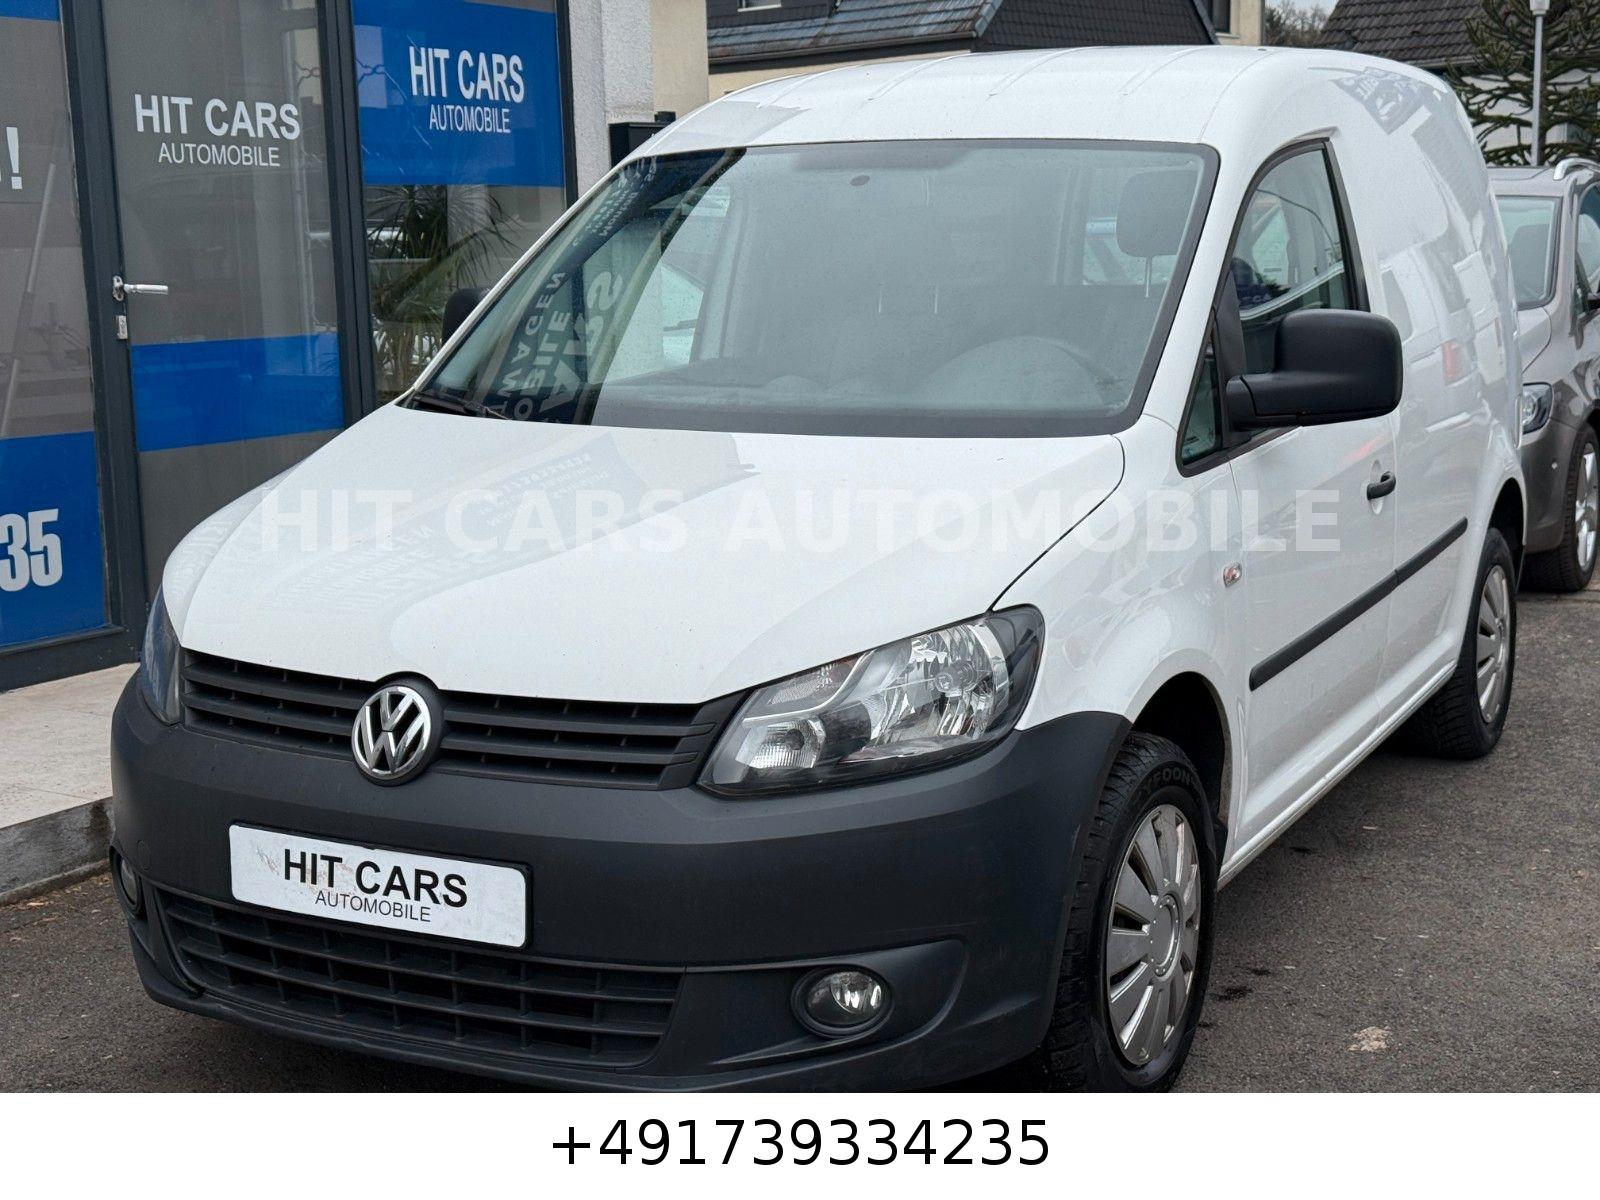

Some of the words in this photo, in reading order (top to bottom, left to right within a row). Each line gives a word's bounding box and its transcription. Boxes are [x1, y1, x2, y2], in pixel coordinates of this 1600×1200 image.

[409, 45, 450, 99] HIT
[457, 50, 524, 103] CARS
[134, 94, 193, 134] HIT
[205, 100, 301, 141] CARS
[429, 104, 511, 134] AUTOMOBILE
[158, 142, 281, 168] AUTOMOBILE
[0, 508, 63, 592] 35
[284, 849, 343, 888] HIT
[355, 861, 467, 908] CARS
[315, 890, 431, 922] AUTOMOBILE
